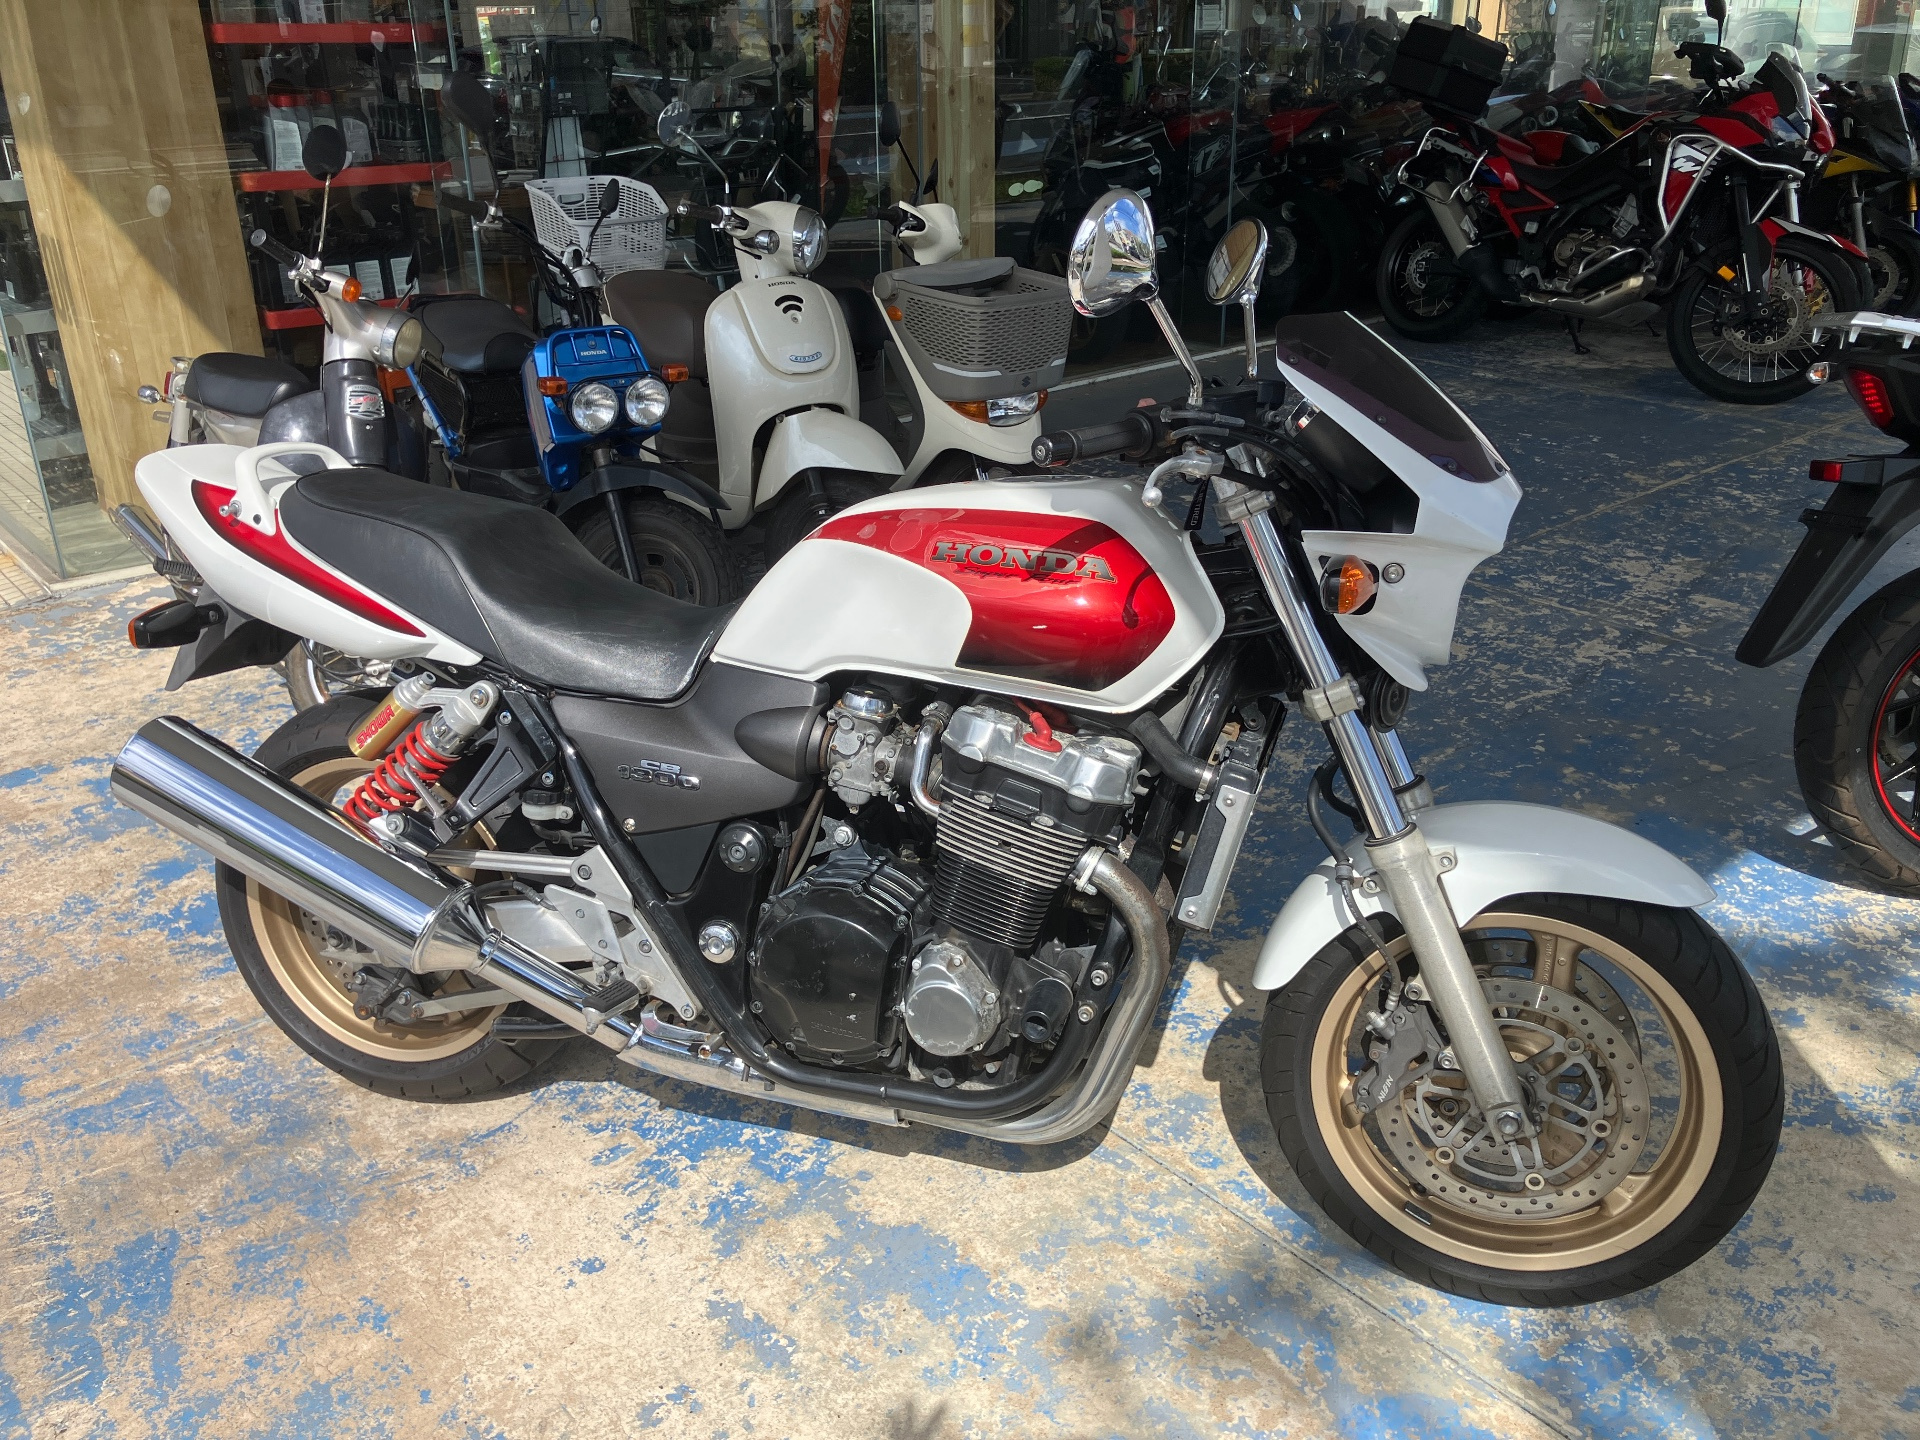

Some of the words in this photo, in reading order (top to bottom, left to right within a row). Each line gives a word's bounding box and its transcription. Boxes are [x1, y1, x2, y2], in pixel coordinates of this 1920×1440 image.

[930, 541, 1117, 583] HONDA
[356, 704, 396, 749] SHOWA
[617, 764, 701, 791] 1300
[640, 759, 681, 774] CB
